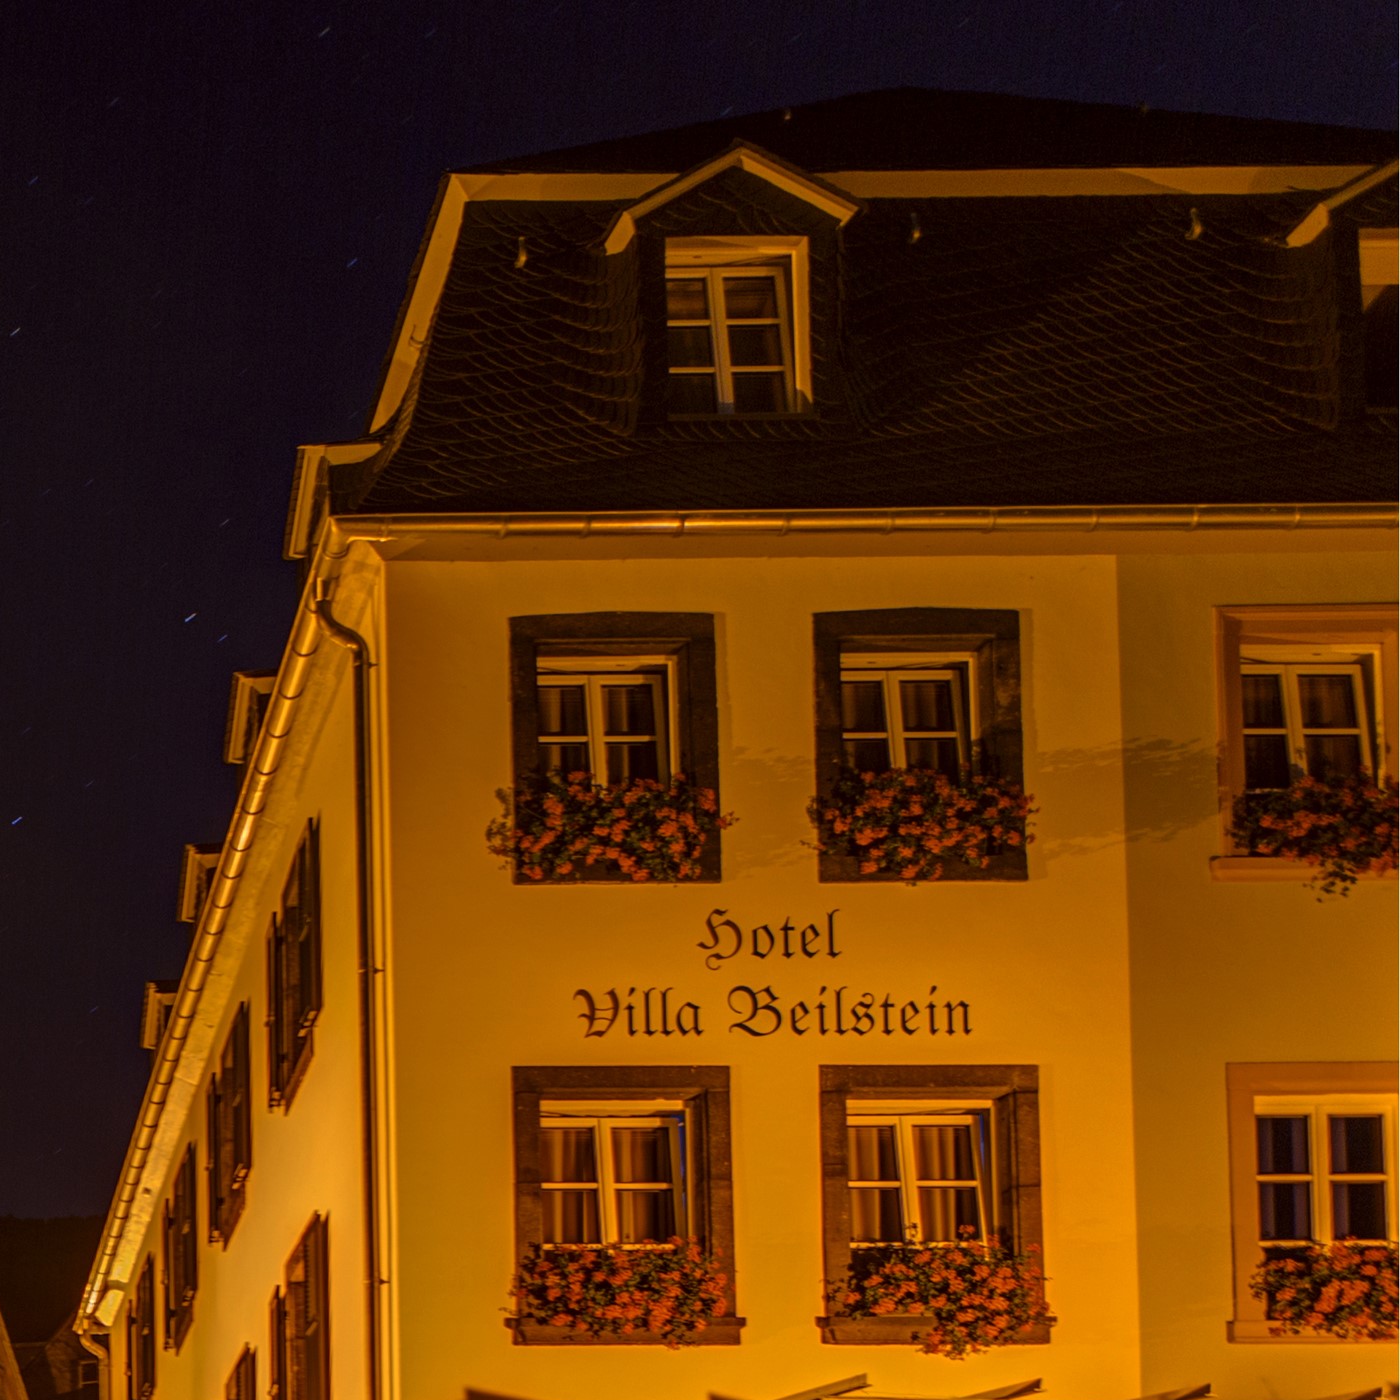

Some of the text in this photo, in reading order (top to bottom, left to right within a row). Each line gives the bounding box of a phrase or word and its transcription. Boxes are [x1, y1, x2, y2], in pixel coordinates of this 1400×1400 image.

[696, 908, 843, 970] Hotel
[572, 984, 974, 1038] Villa Beilstein
